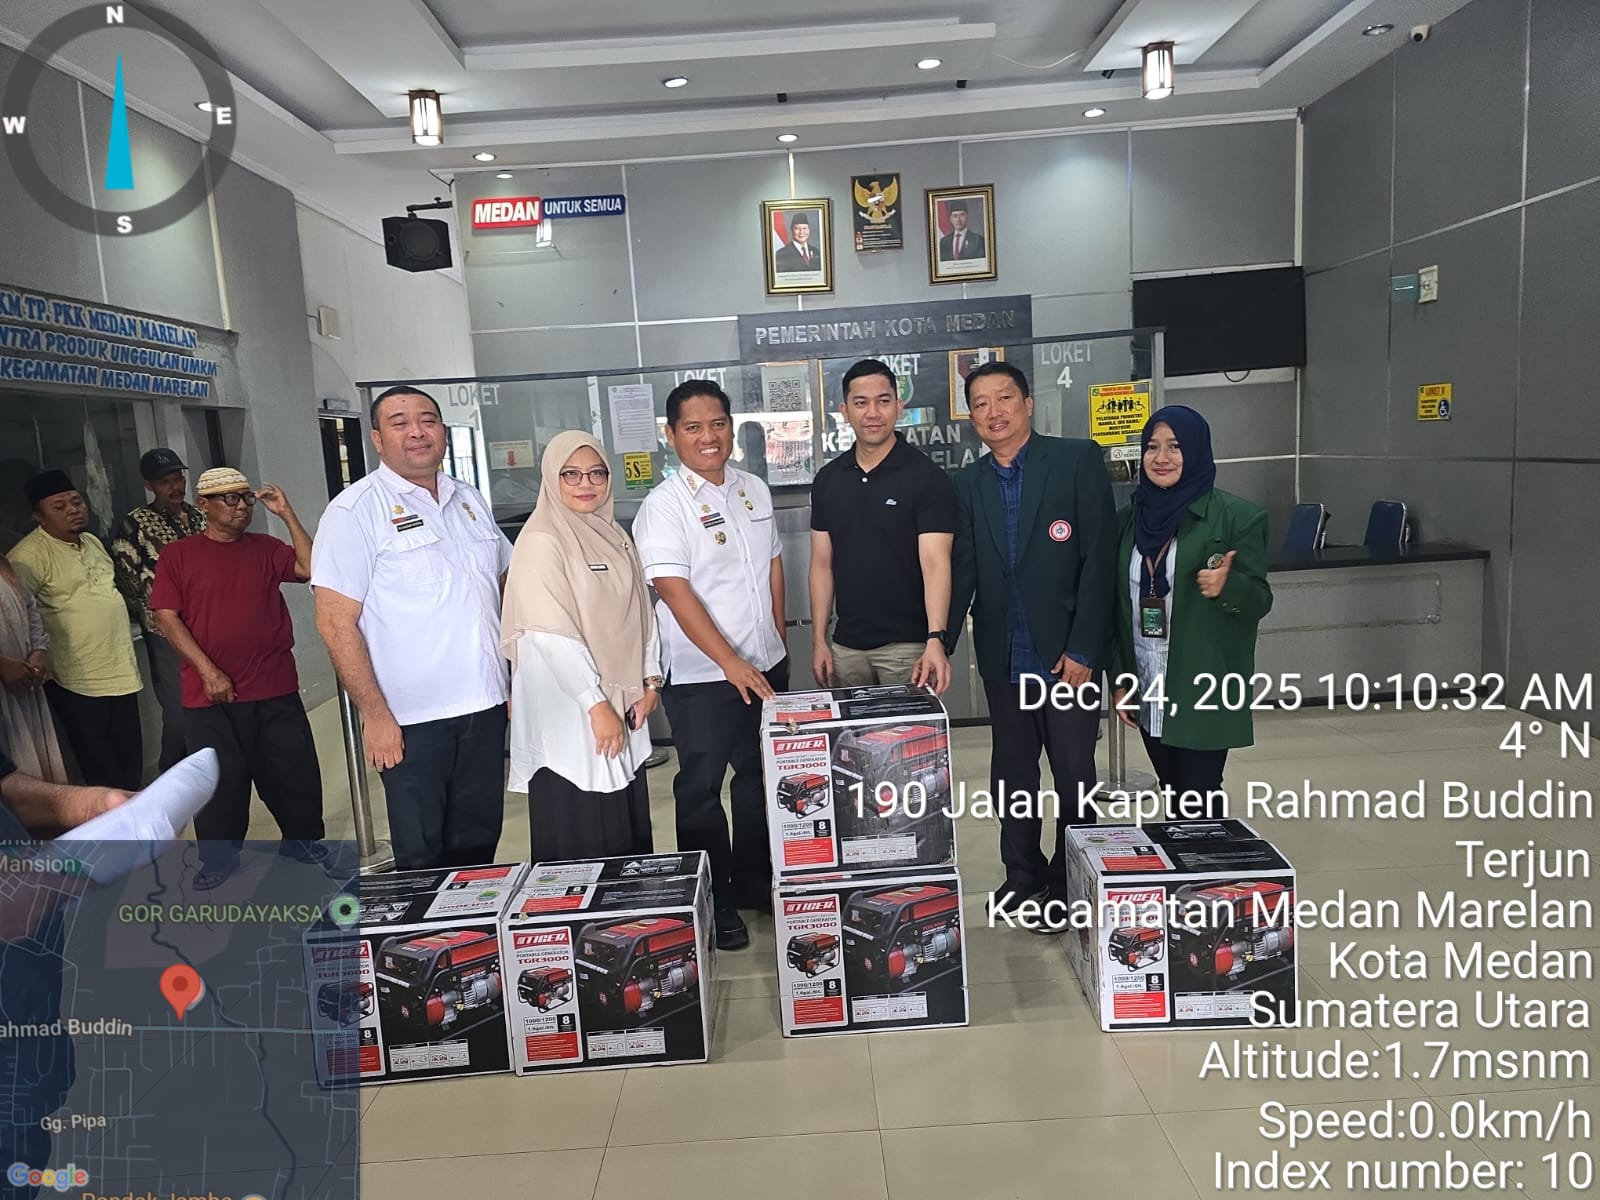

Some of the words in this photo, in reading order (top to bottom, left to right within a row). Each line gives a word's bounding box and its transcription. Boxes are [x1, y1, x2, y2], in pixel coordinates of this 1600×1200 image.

[474, 201, 540, 223] MEDAN
[544, 200, 582, 214] UNTUK
[584, 198, 622, 212] SEMUA
[53, 302, 85, 328] PKK
[88, 309, 136, 337] MEDAN
[140, 319, 197, 348] MARELAN
[755, 321, 876, 345] PEMERINTAH
[885, 317, 936, 337] KOTA
[946, 310, 1015, 332] MEDAN
[46, 333, 107, 359] PRODUK
[111, 344, 179, 371] UNGGULAN
[181, 358, 217, 377] UMKM
[1041, 341, 1092, 365] LOKET
[1, 357, 97, 385] KECAMATAN
[101, 370, 150, 392] MEDAN
[152, 377, 208, 397] MARELAN
[1056, 366, 1073, 388] 4
[448, 384, 500, 406] LOKET
[469, 409, 480, 431] 1
[819, 821, 826, 830] 8
[517, 955, 569, 964] TGR3000
[829, 980, 836, 989] 8
[1151, 975, 1159, 984] 8
[562, 1015, 570, 1025] 8
[364, 1029, 372, 1038] 8
